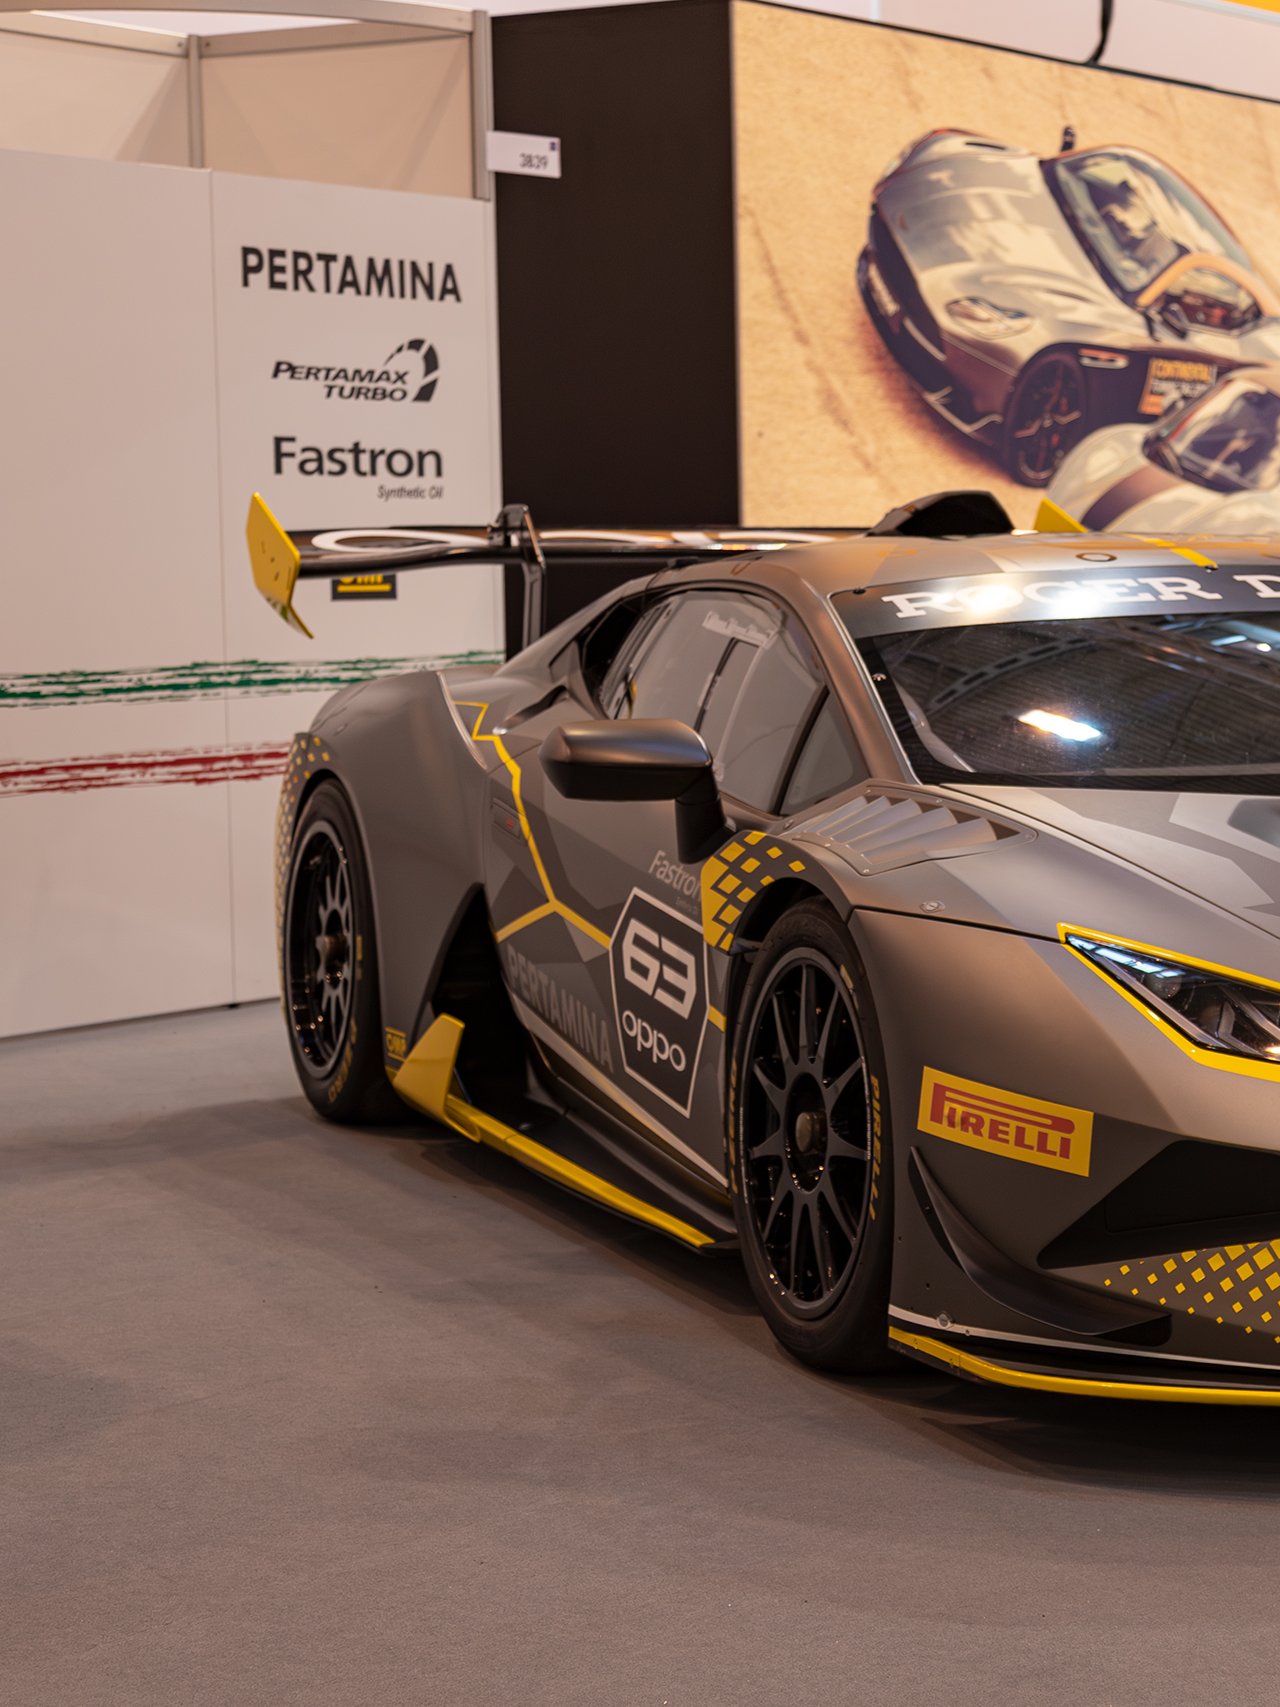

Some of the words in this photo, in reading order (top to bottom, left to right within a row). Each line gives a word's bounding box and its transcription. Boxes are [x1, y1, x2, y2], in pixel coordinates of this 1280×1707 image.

[242, 246, 462, 303] PERTAMINA
[271, 361, 409, 385] PERTAMAX
[324, 384, 407, 402] TURBO
[273, 436, 443, 478] Fastron
[377, 485, 426, 502] Synthetic
[429, 485, 444, 499] Oil
[881, 576, 1223, 618] ROGER
[622, 917, 697, 1020] 63
[507, 942, 614, 1074] PERTAMINA
[622, 1009, 687, 1072] oppo
[870, 1074, 882, 1221] PIRELLI
[929, 1082, 1076, 1160] PIRELLI
